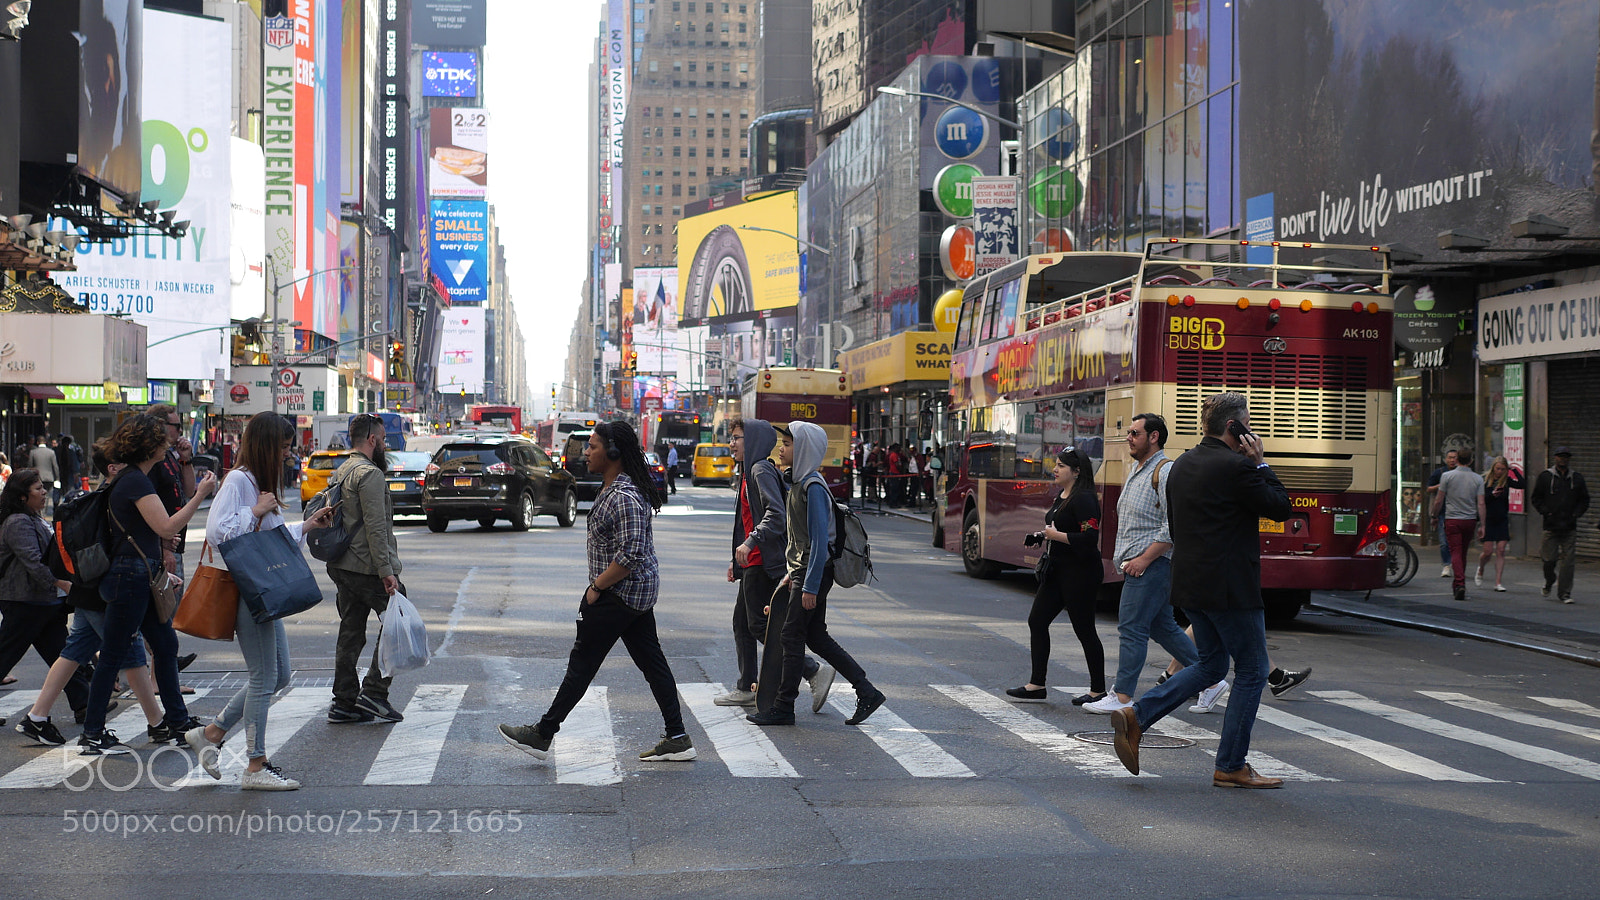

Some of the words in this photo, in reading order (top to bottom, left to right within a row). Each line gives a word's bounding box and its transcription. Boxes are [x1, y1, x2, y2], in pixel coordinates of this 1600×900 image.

[268, 30, 292, 45] NFL
[385, 30, 397, 77] EXPRESS
[437, 68, 472, 81] TDK
[946, 123, 967, 140] m
[266, 66, 293, 216] EXPERIENCE
[385, 147, 396, 200] EXPRESS
[1280, 210, 1316, 239] DON'T
[1319, 190, 1355, 242] live
[1358, 173, 1393, 238] life
[1395, 175, 1465, 213] WITHOUT
[435, 220, 483, 231] SMALL
[435, 233, 484, 241] BUSINESS
[440, 243, 462, 252] every
[463, 243, 479, 252] day
[66, 276, 94, 288] ARIEL
[97, 277, 140, 291] SCHUSTER
[155, 281, 180, 293] JASON
[182, 282, 215, 294] WECKER
[372, 246, 382, 352] PALACE
[1170, 316, 1201, 333] BIG
[1482, 306, 1524, 349] GOING
[1528, 302, 1554, 343] OUT
[1558, 299, 1576, 341] OF
[1169, 334, 1200, 349] BUS
[1343, 328, 1358, 338] AK
[1361, 329, 1379, 339] 103
[916, 343, 953, 355] SCA
[1037, 335, 1067, 388] NEW
[1069, 327, 1106, 382] YORK
[288, 403, 306, 411] CLUB
[790, 403, 806, 411] BIG
